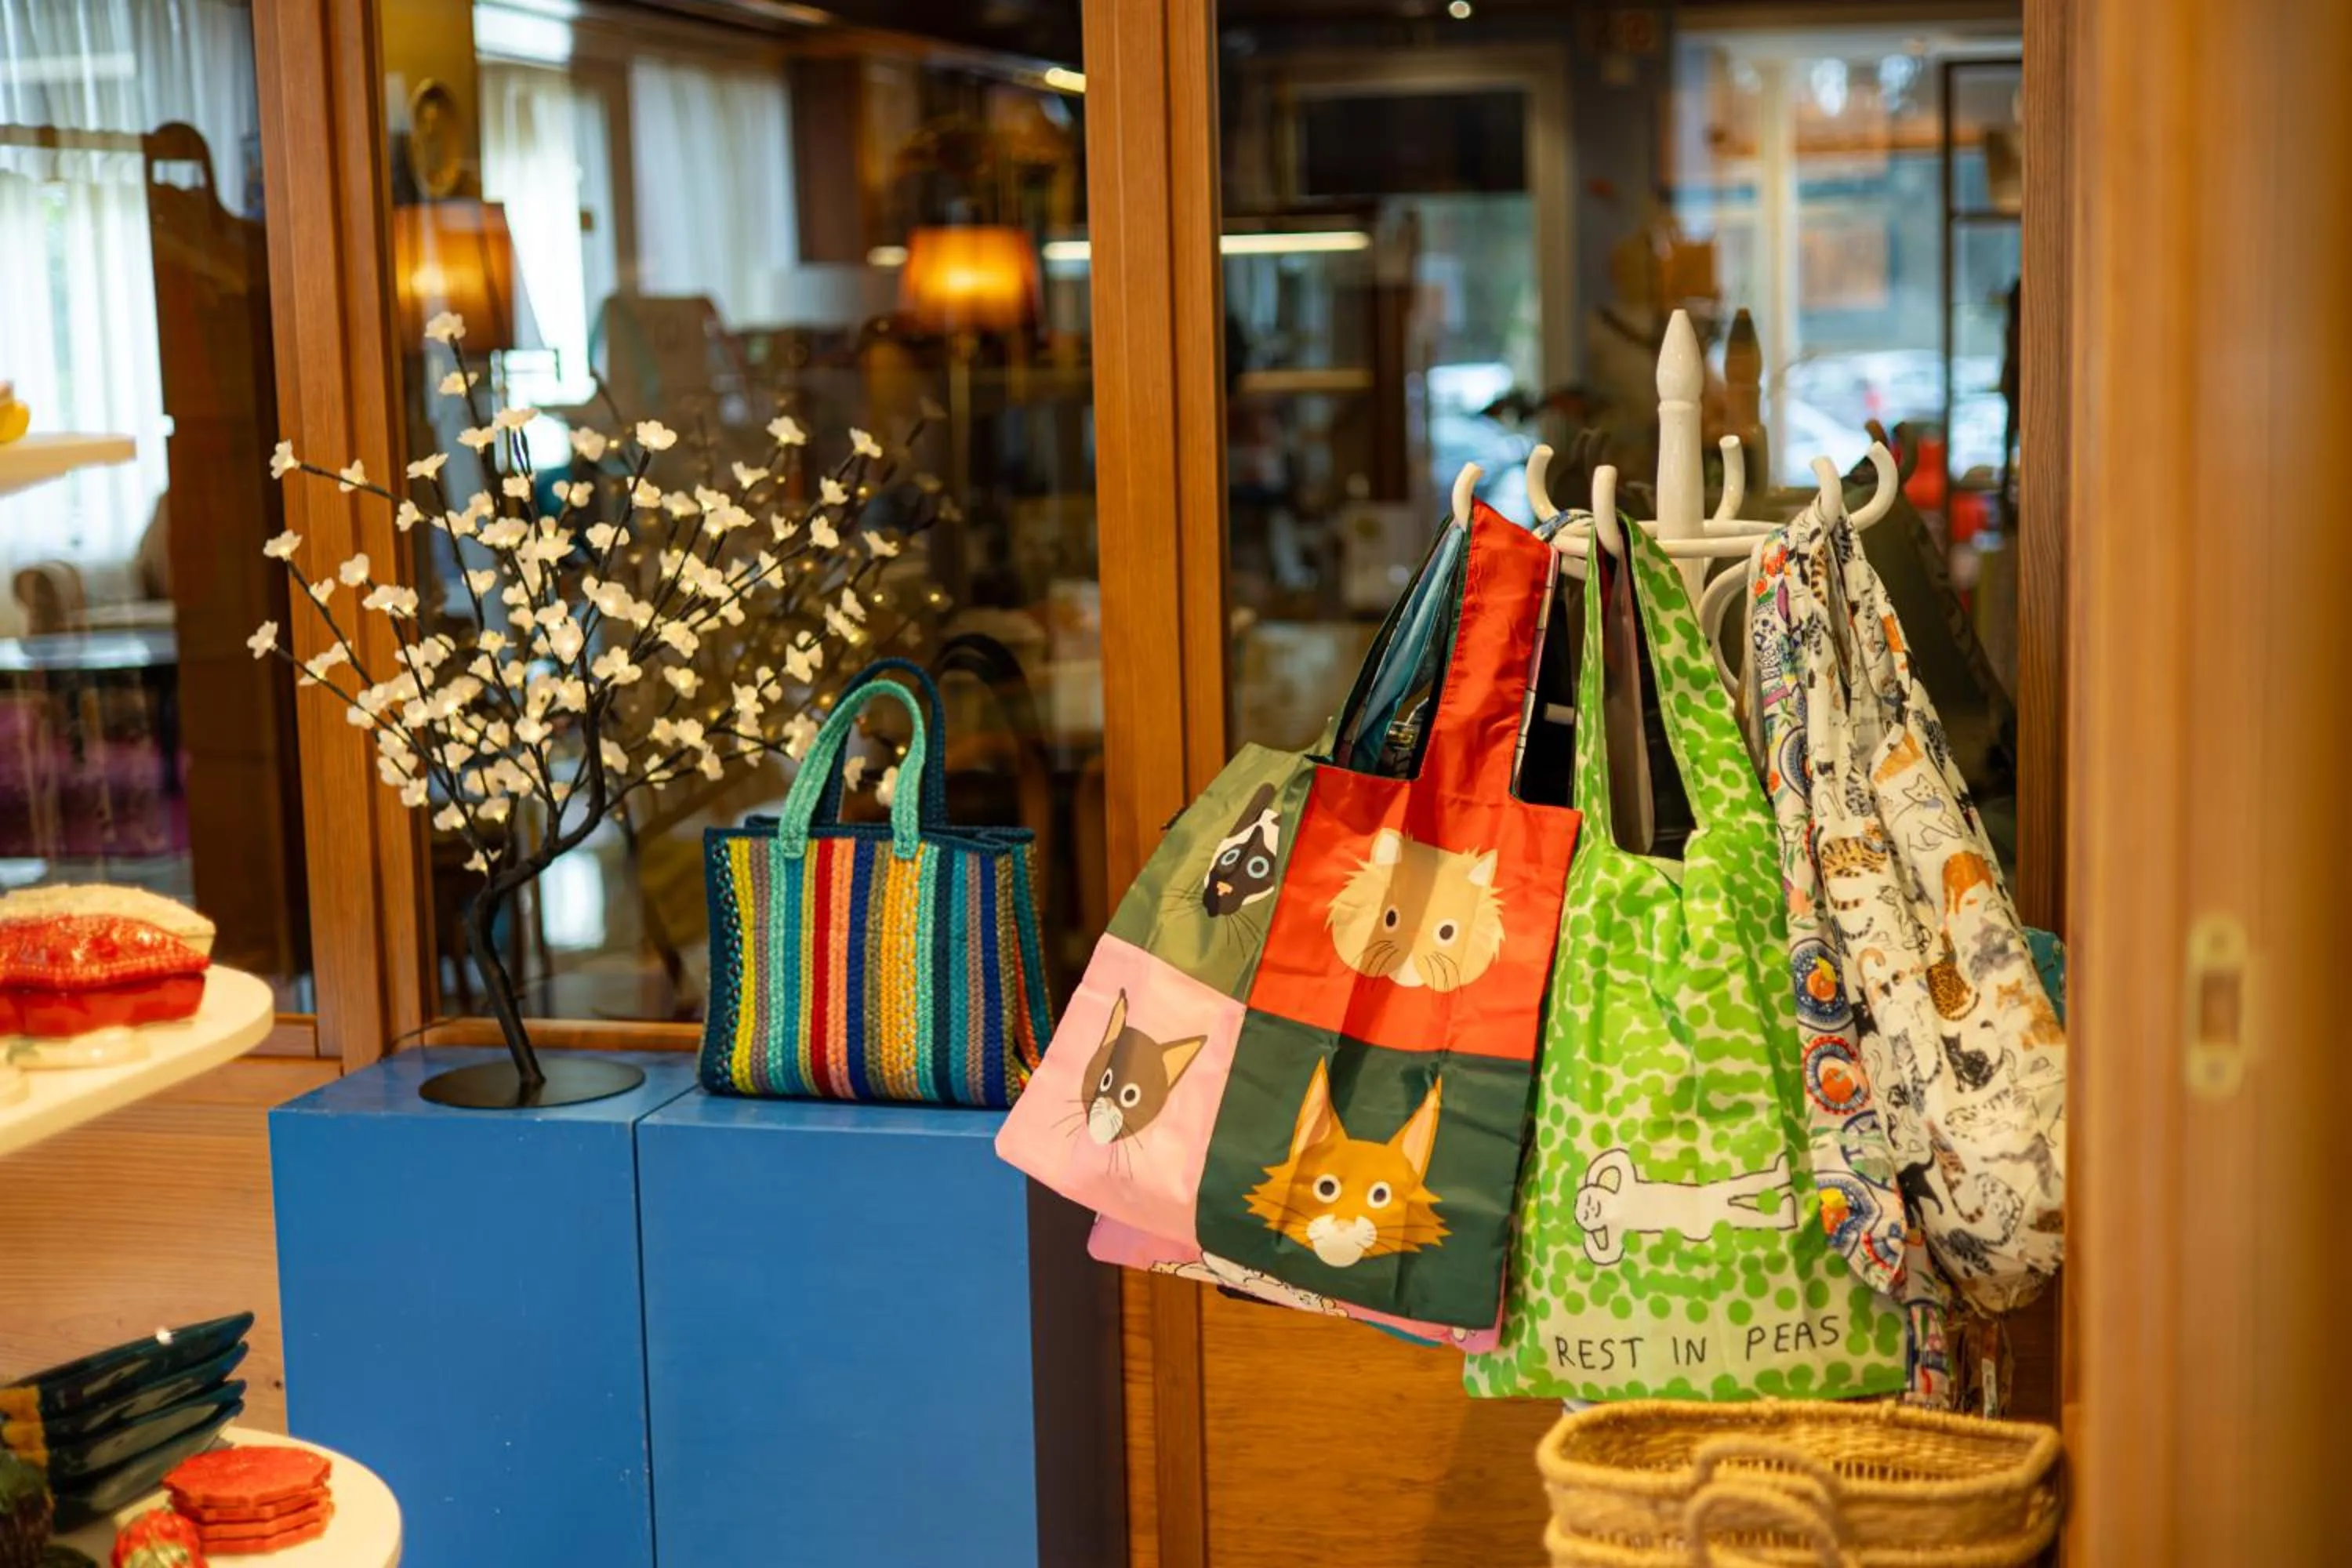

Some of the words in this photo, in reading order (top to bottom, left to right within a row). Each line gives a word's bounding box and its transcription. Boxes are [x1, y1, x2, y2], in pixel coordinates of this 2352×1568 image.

[1554, 1335, 1645, 1370] REST
[1671, 1336, 1707, 1367] IN
[1745, 1315, 1840, 1361] PEAS
